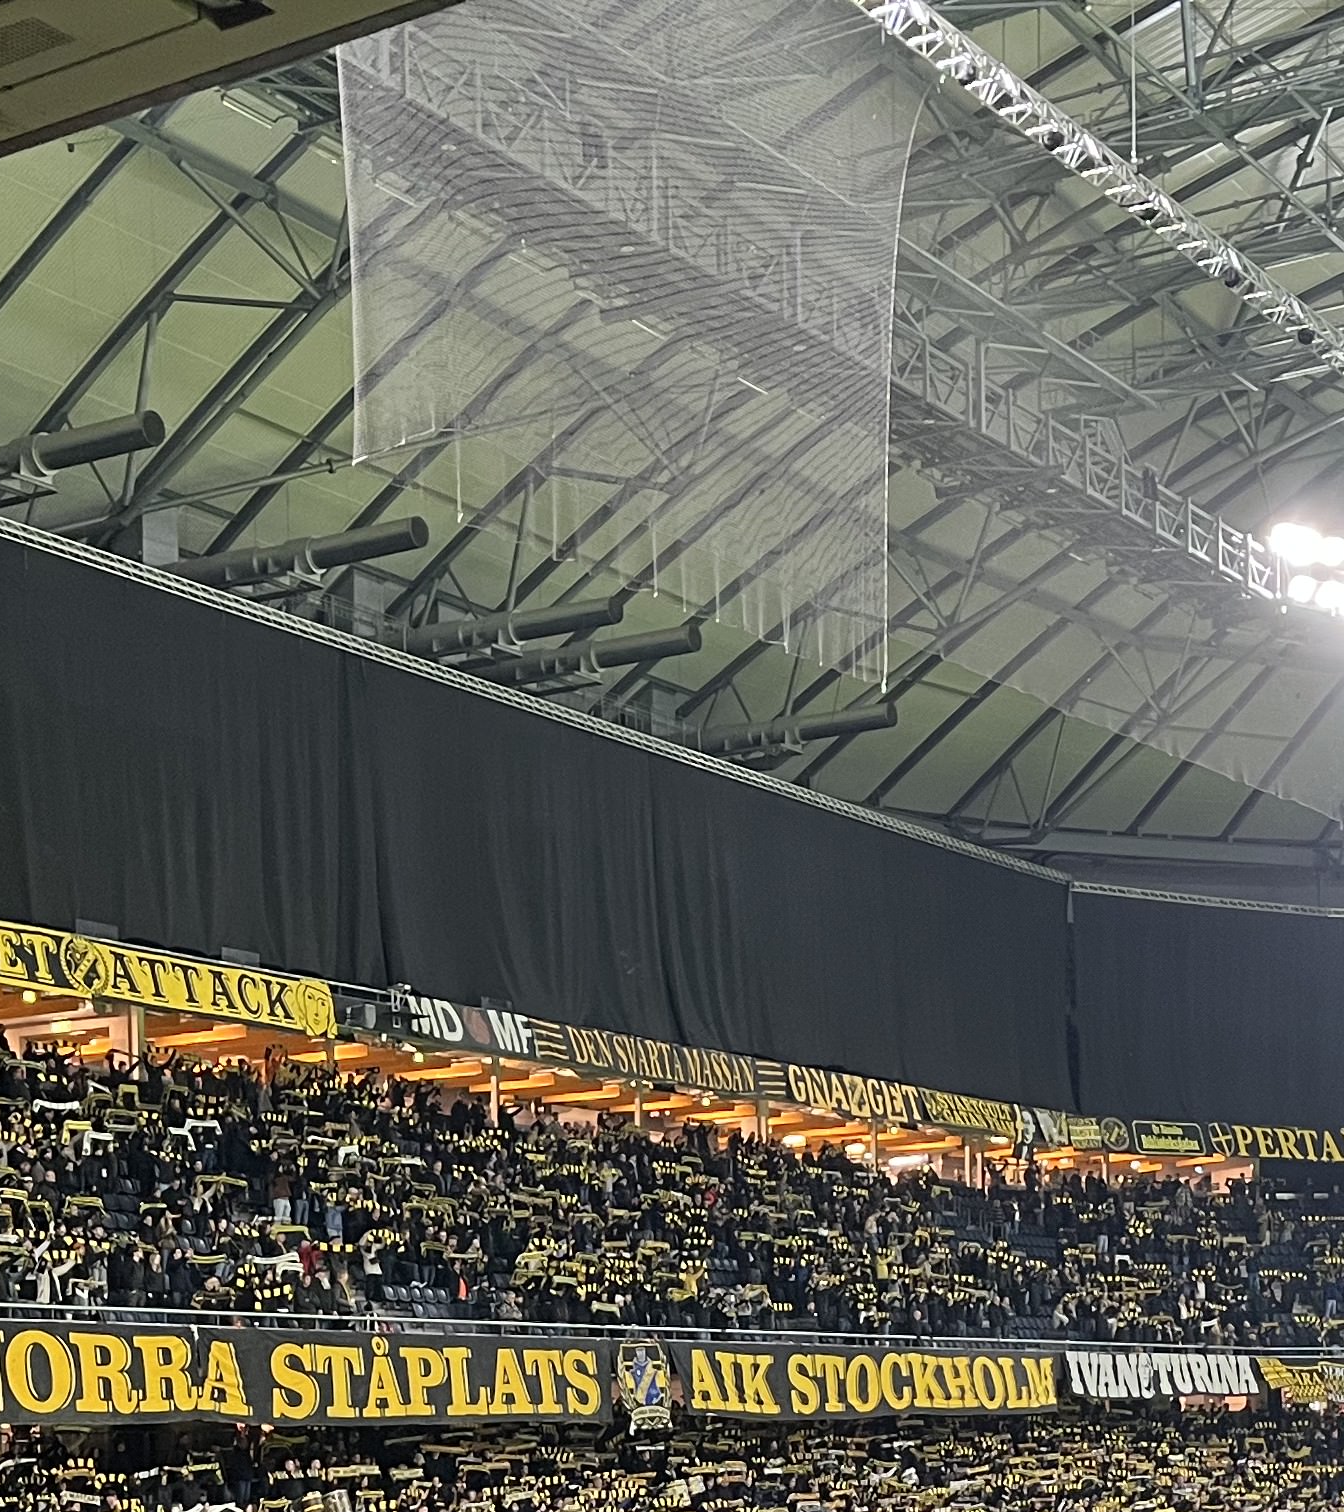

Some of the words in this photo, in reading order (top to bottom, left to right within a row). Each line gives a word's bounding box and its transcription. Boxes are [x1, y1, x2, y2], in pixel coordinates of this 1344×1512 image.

[110, 952, 294, 1022] ATTACK
[565, 1026, 614, 1069] DEN
[615, 1036, 686, 1081] SVARTA
[687, 1050, 756, 1095] MASSAN
[271, 1337, 603, 1420] STÅPLATS
[690, 1347, 780, 1414] AIK
[787, 1351, 1057, 1414] STOCKHOLM
[1152, 1352, 1259, 1396] TURINA
